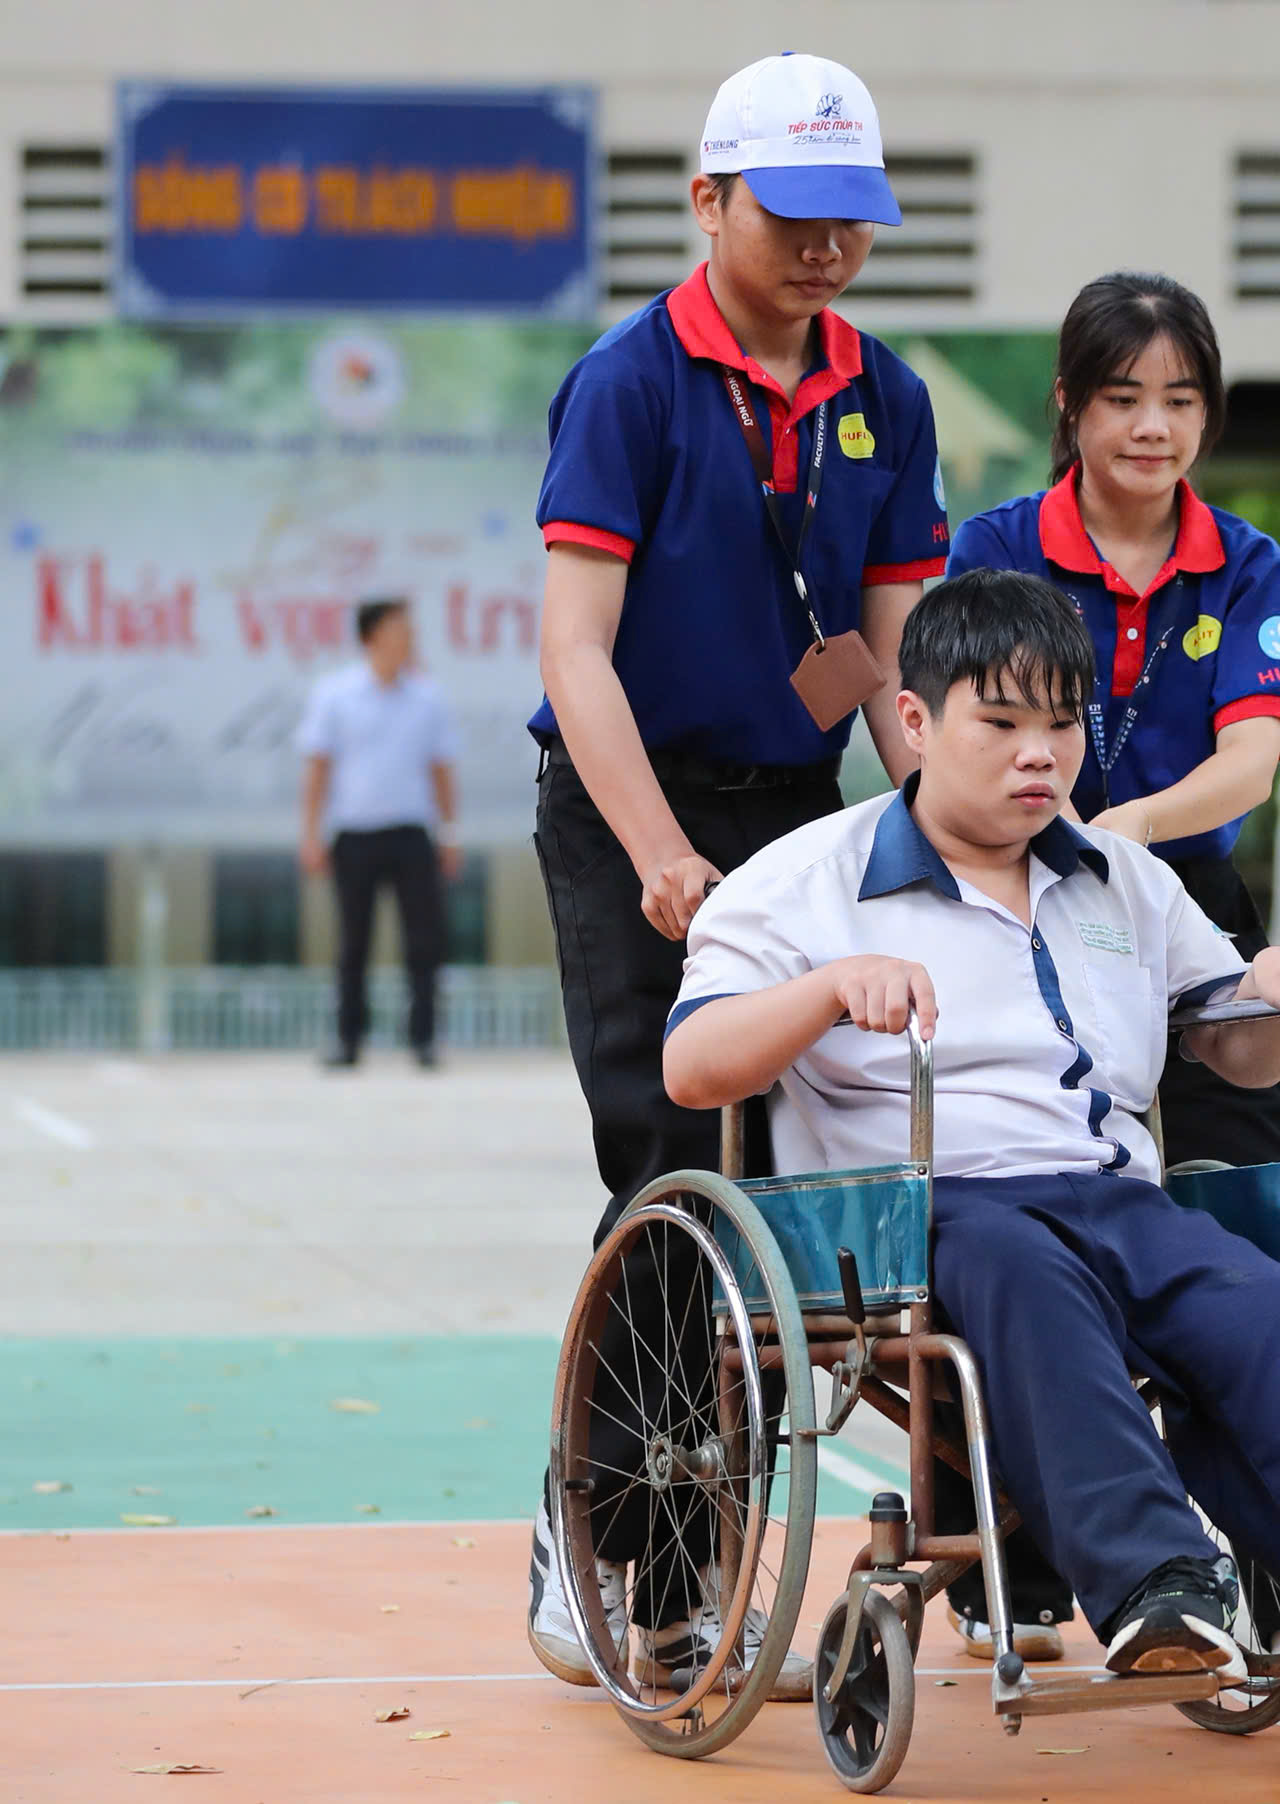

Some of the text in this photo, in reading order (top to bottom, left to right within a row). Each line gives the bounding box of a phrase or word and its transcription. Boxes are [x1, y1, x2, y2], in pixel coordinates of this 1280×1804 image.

[788, 119, 808, 134] TIẾP
[810, 119, 831, 132] SỨC
[728, 376, 744, 406] NGOẠI
[818, 418, 825, 430] OF
[814, 429, 825, 468] FACULTY
